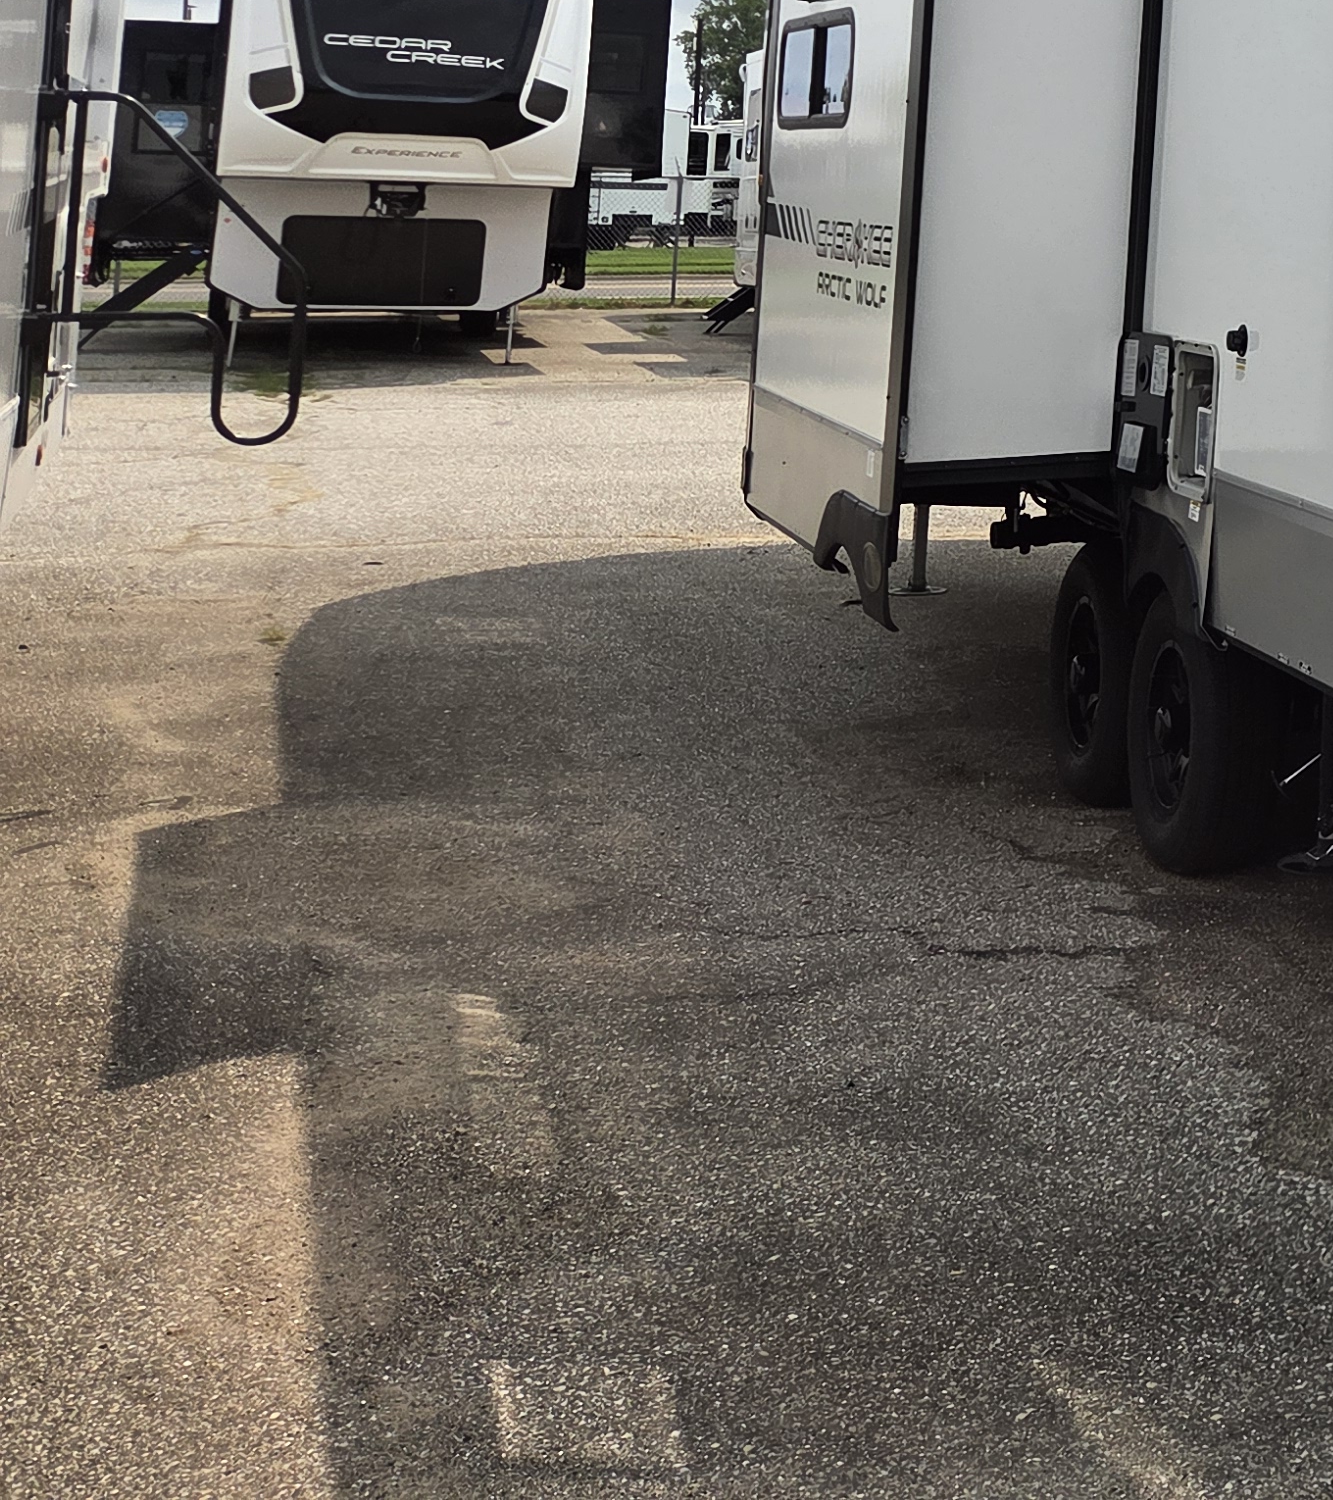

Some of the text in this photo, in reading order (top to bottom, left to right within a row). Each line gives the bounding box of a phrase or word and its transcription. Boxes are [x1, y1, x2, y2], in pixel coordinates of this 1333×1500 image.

[323, 33, 452, 52] CEDAR
[386, 51, 505, 70] CREEK
[816, 271, 887, 309] ARCTIC WOLF
